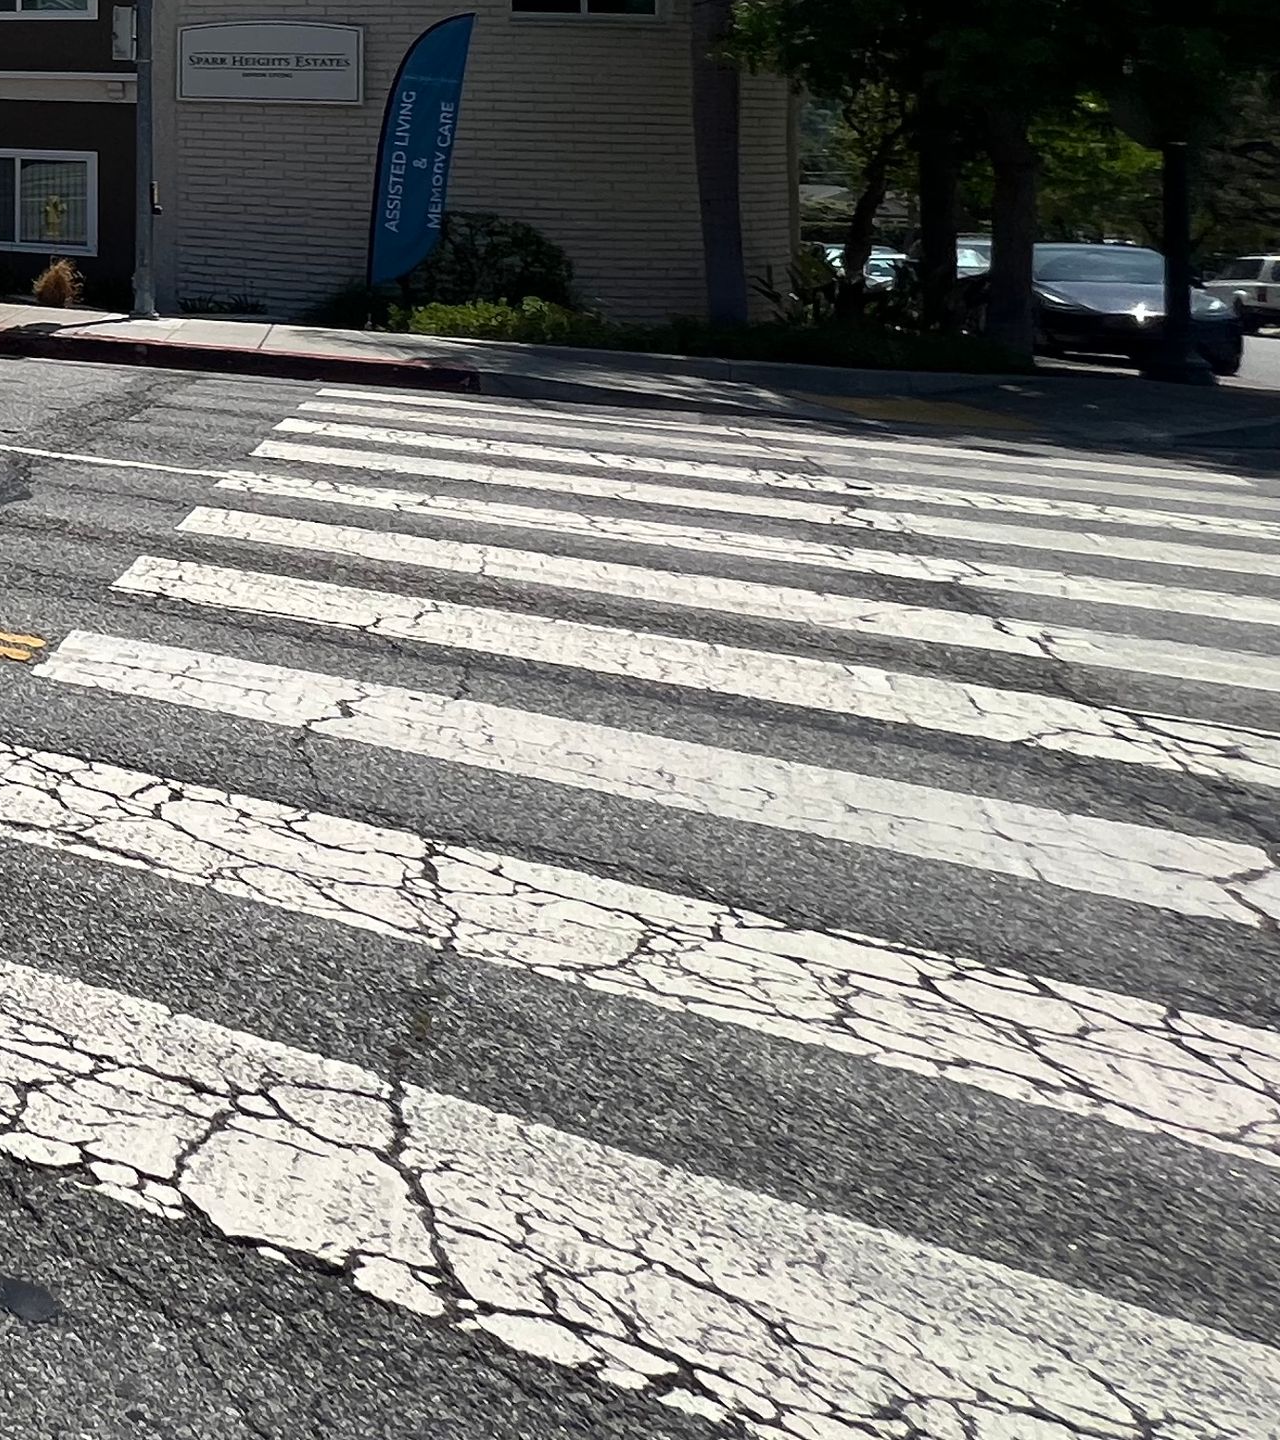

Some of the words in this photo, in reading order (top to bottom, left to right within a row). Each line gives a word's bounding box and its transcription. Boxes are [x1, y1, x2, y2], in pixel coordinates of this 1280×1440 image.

[232, 55, 290, 67] HEIGHTS
[295, 56, 351, 68] ESTATES
[394, 91, 416, 146] LIVING
[412, 158, 427, 169] &
[426, 151, 446, 229] MEMORY
[436, 101, 454, 148] CARE
[384, 151, 407, 233] ASSISTED
